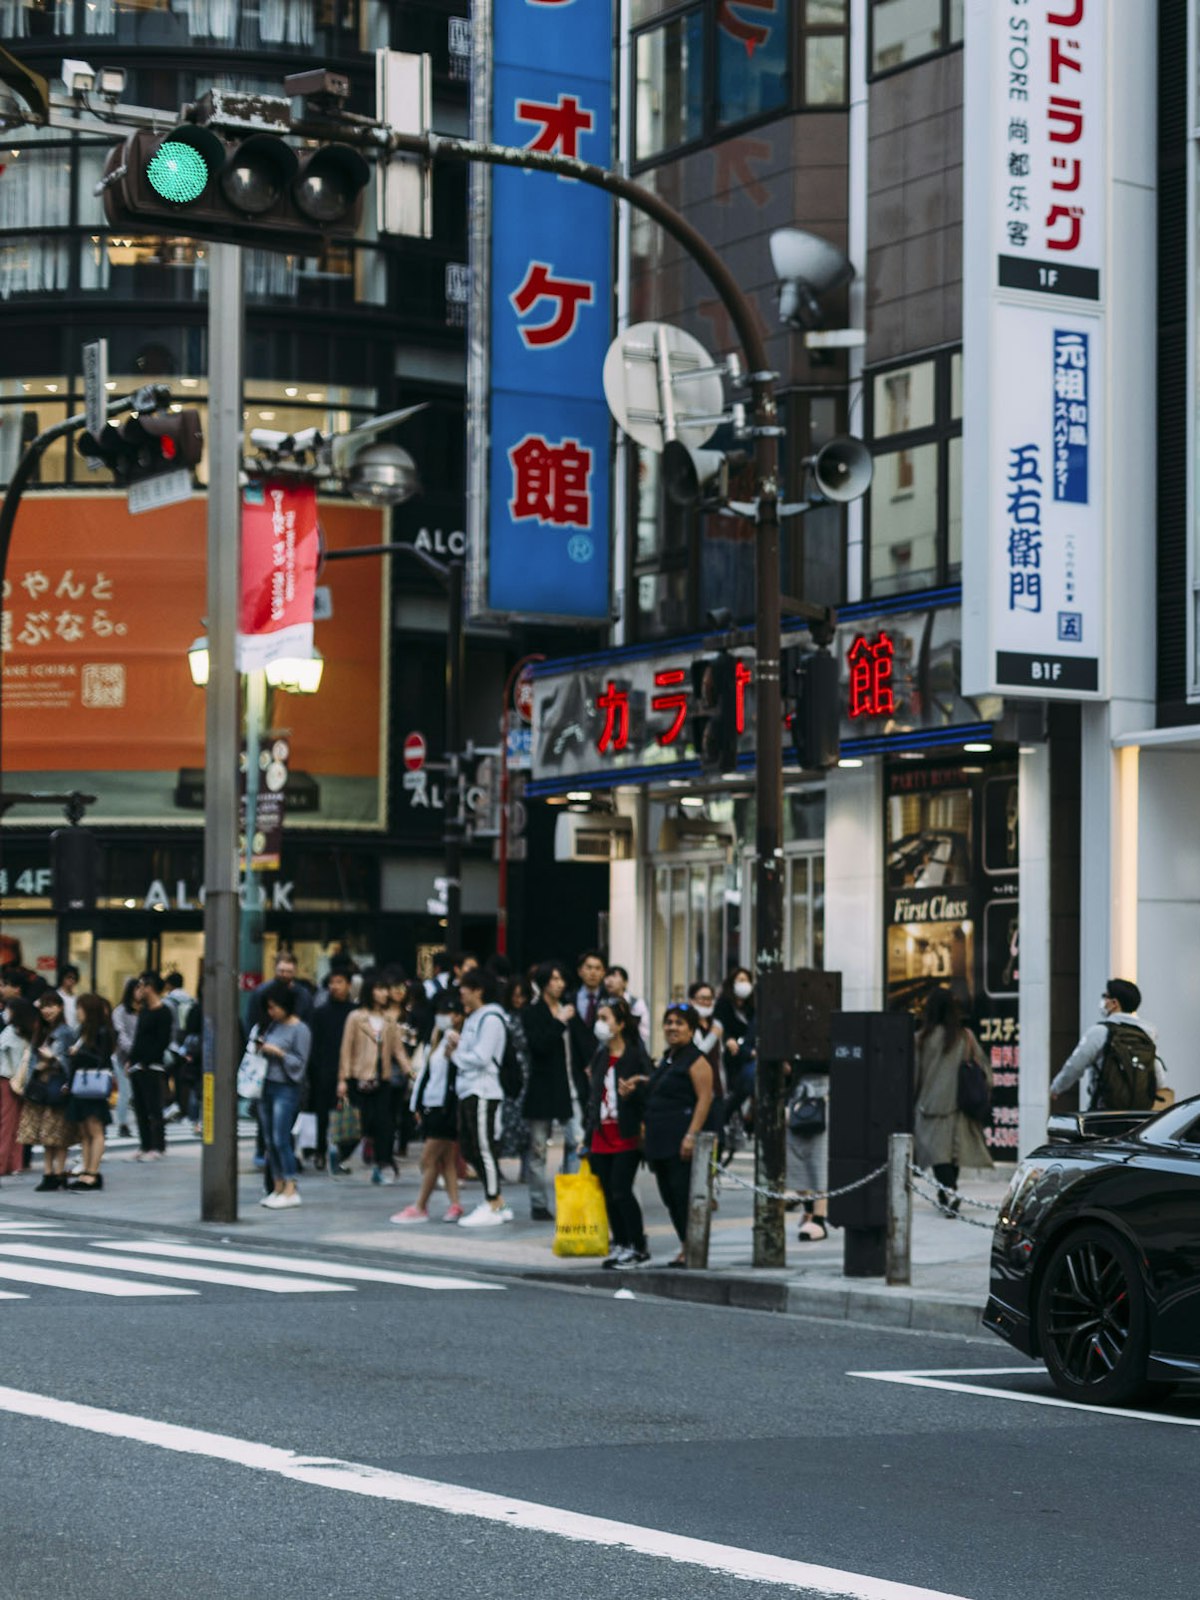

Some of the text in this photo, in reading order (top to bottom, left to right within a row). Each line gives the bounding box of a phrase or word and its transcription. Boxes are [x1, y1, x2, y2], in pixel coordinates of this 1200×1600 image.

[1009, 16, 1029, 102] STORE
[1038, 268, 1059, 287] 1F
[1055, 334, 1086, 400] 元祖
[1007, 444, 1043, 613] 五右衛門
[1031, 661, 1062, 681] B1F
[15, 868, 52, 895] 4F
[893, 896, 968, 922] First Class
